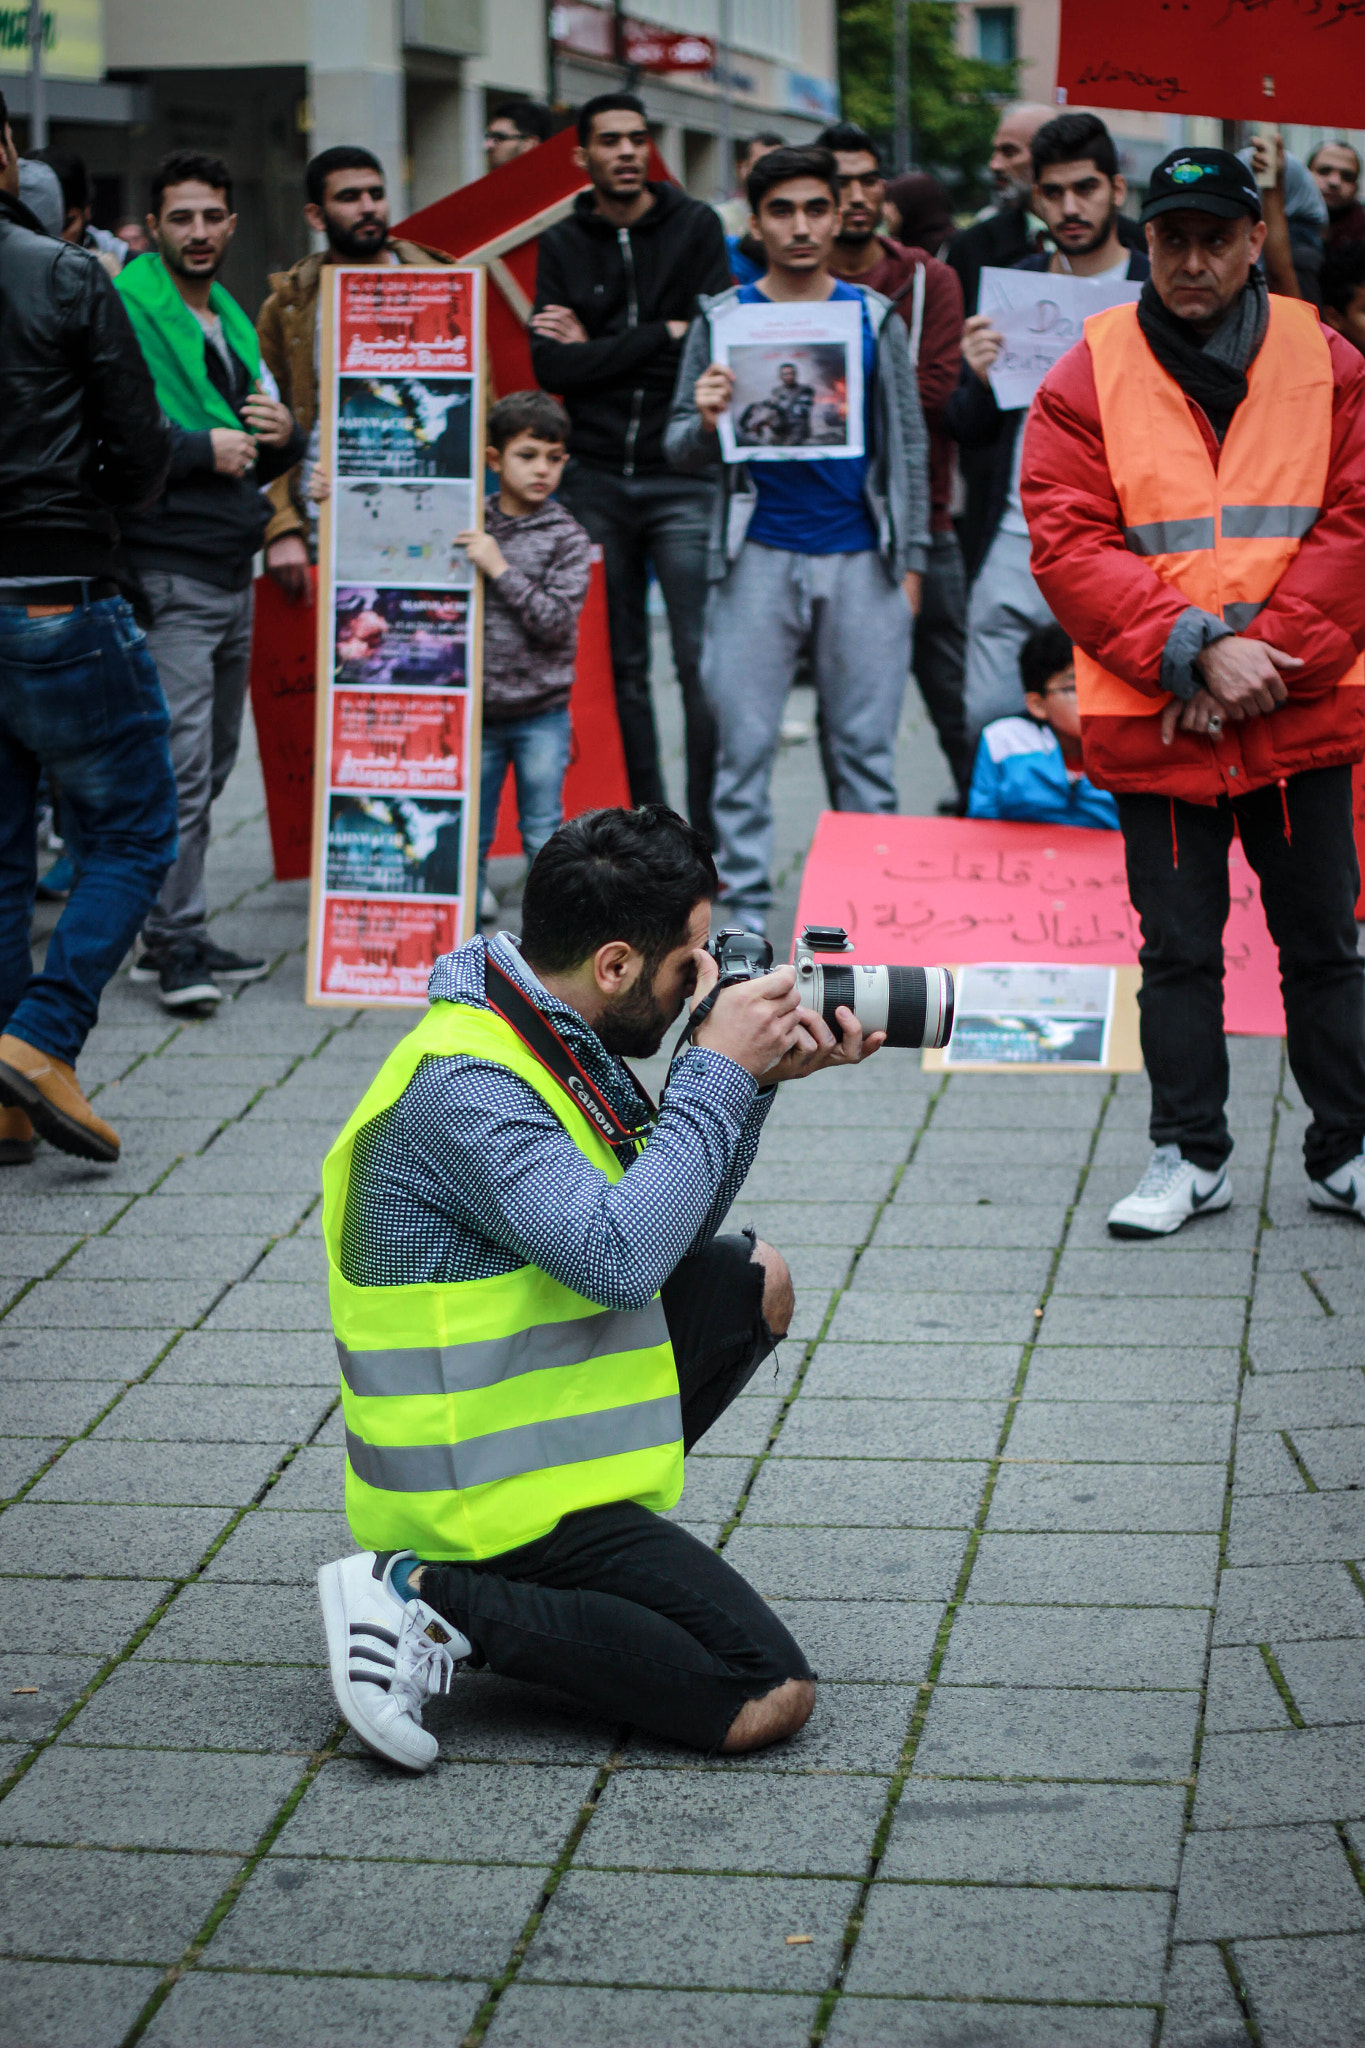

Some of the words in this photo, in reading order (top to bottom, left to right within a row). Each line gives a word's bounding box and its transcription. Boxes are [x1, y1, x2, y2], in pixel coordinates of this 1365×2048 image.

[1028, 299, 1086, 338] Da
[345, 350, 416, 370] #Aleppo
[417, 350, 467, 367] Burns
[568, 1076, 615, 1135] Canon
